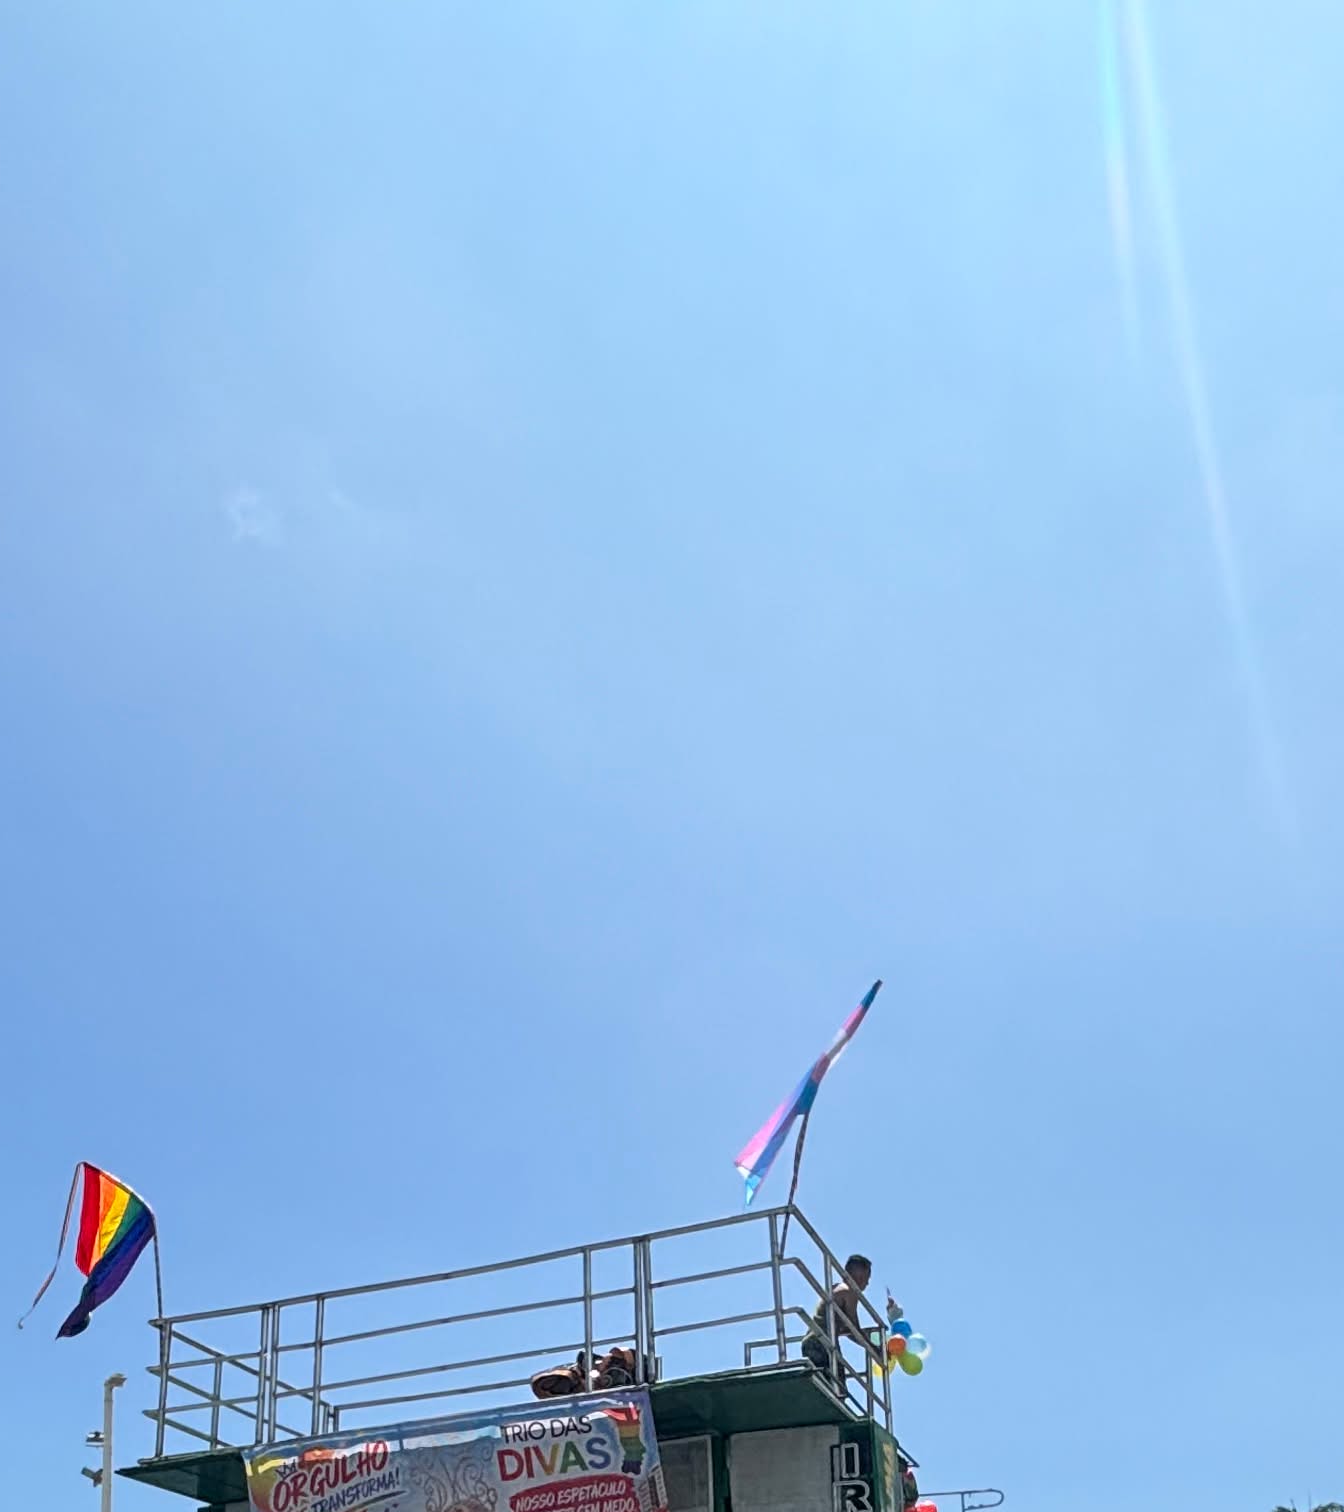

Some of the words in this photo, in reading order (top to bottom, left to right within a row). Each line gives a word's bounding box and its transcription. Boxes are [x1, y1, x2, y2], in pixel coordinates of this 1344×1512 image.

[501, 1422, 545, 1444] TRIO
[551, 1416, 592, 1437] DAS
[272, 1440, 389, 1512] ORGULHO
[497, 1437, 611, 1481] DIVAS
[516, 1493, 555, 1512] NOSSO
[557, 1480, 626, 1504] ESPETÁCULO
